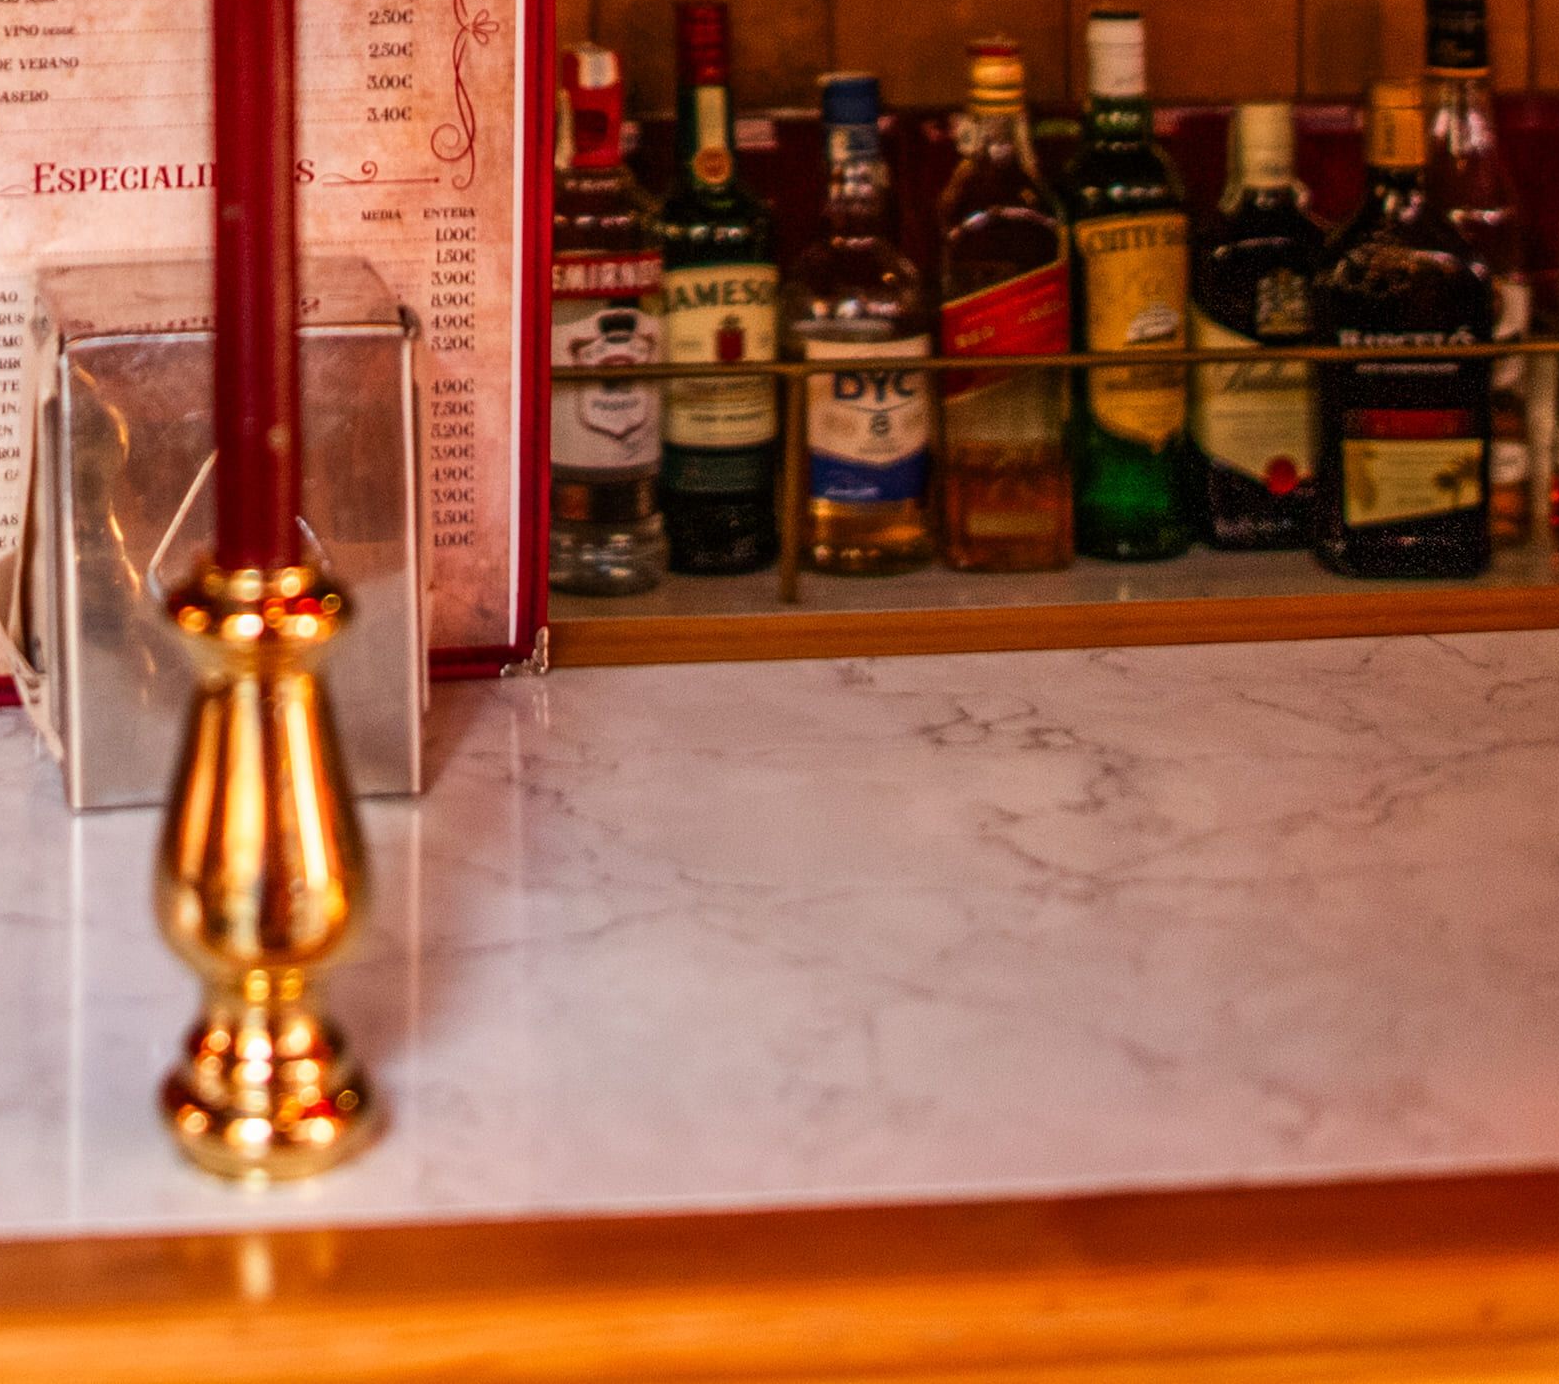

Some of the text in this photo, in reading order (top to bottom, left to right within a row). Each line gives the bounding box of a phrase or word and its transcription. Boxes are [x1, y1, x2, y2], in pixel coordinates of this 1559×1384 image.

[4, 24, 38, 38] VINO
[19, 56, 78, 70] VERANO
[33, 159, 314, 194] ESPECIALIS
